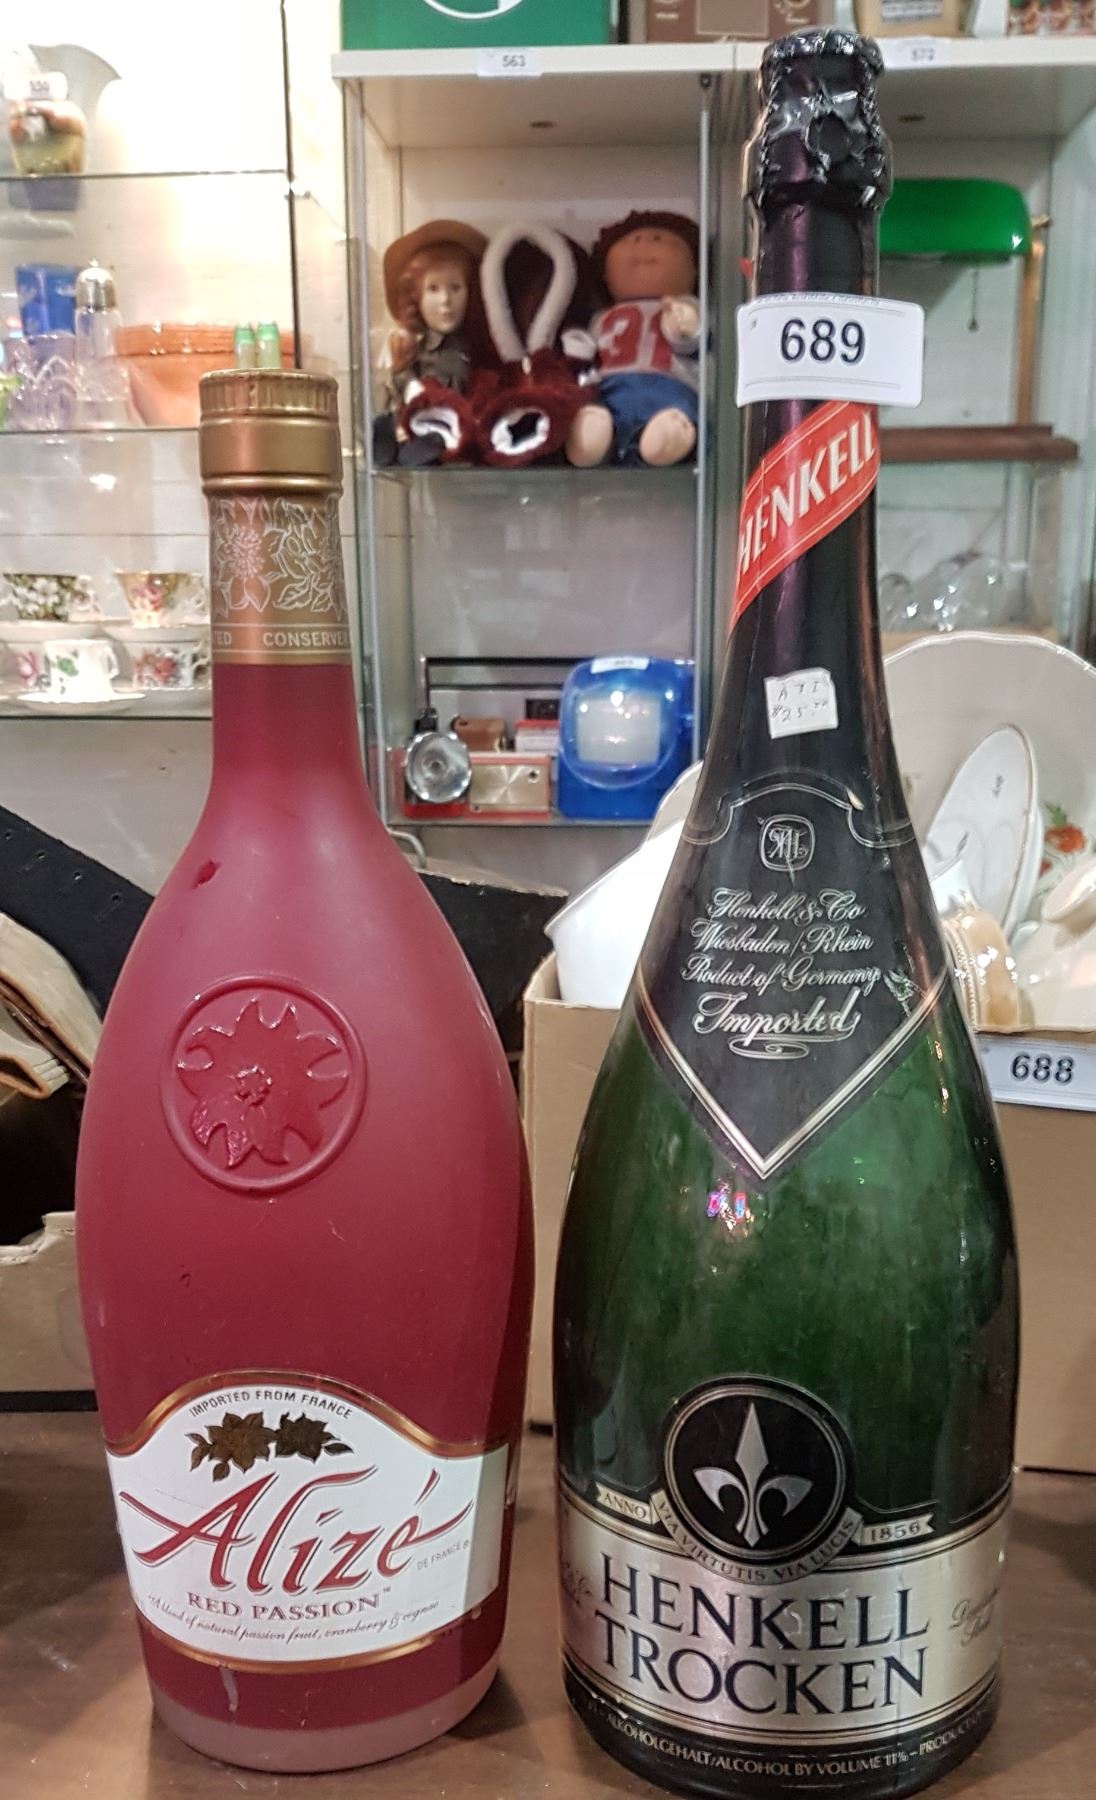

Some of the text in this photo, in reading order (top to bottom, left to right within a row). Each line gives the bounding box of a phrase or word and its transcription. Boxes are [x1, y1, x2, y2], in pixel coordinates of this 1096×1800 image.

[780, 318, 866, 364] 689
[739, 410, 876, 576] HENKELL
[707, 887, 805, 921] Henkell
[795, 900, 823, 926] &
[680, 953, 882, 996] Product of Germany
[692, 986, 862, 1047] Imported
[1011, 1054, 1073, 1084] 688
[189, 1390, 353, 1420] IMPORTED FROM FRANCE
[603, 1492, 648, 1520] ANNO
[118, 1465, 474, 1597] Alizé
[870, 1520, 921, 1543] 1856
[187, 1591, 243, 1617] RED
[600, 1551, 930, 1651] HENKELL
[197, 1620, 241, 1637] natural
[237, 1626, 286, 1642] passion
[285, 1626, 322, 1645] fruit,
[323, 1618, 388, 1638] cranberry
[595, 1609, 929, 1717] TROCKEN
[794, 1761, 815, 1777] BY
[816, 1756, 881, 1776] VOLUME
